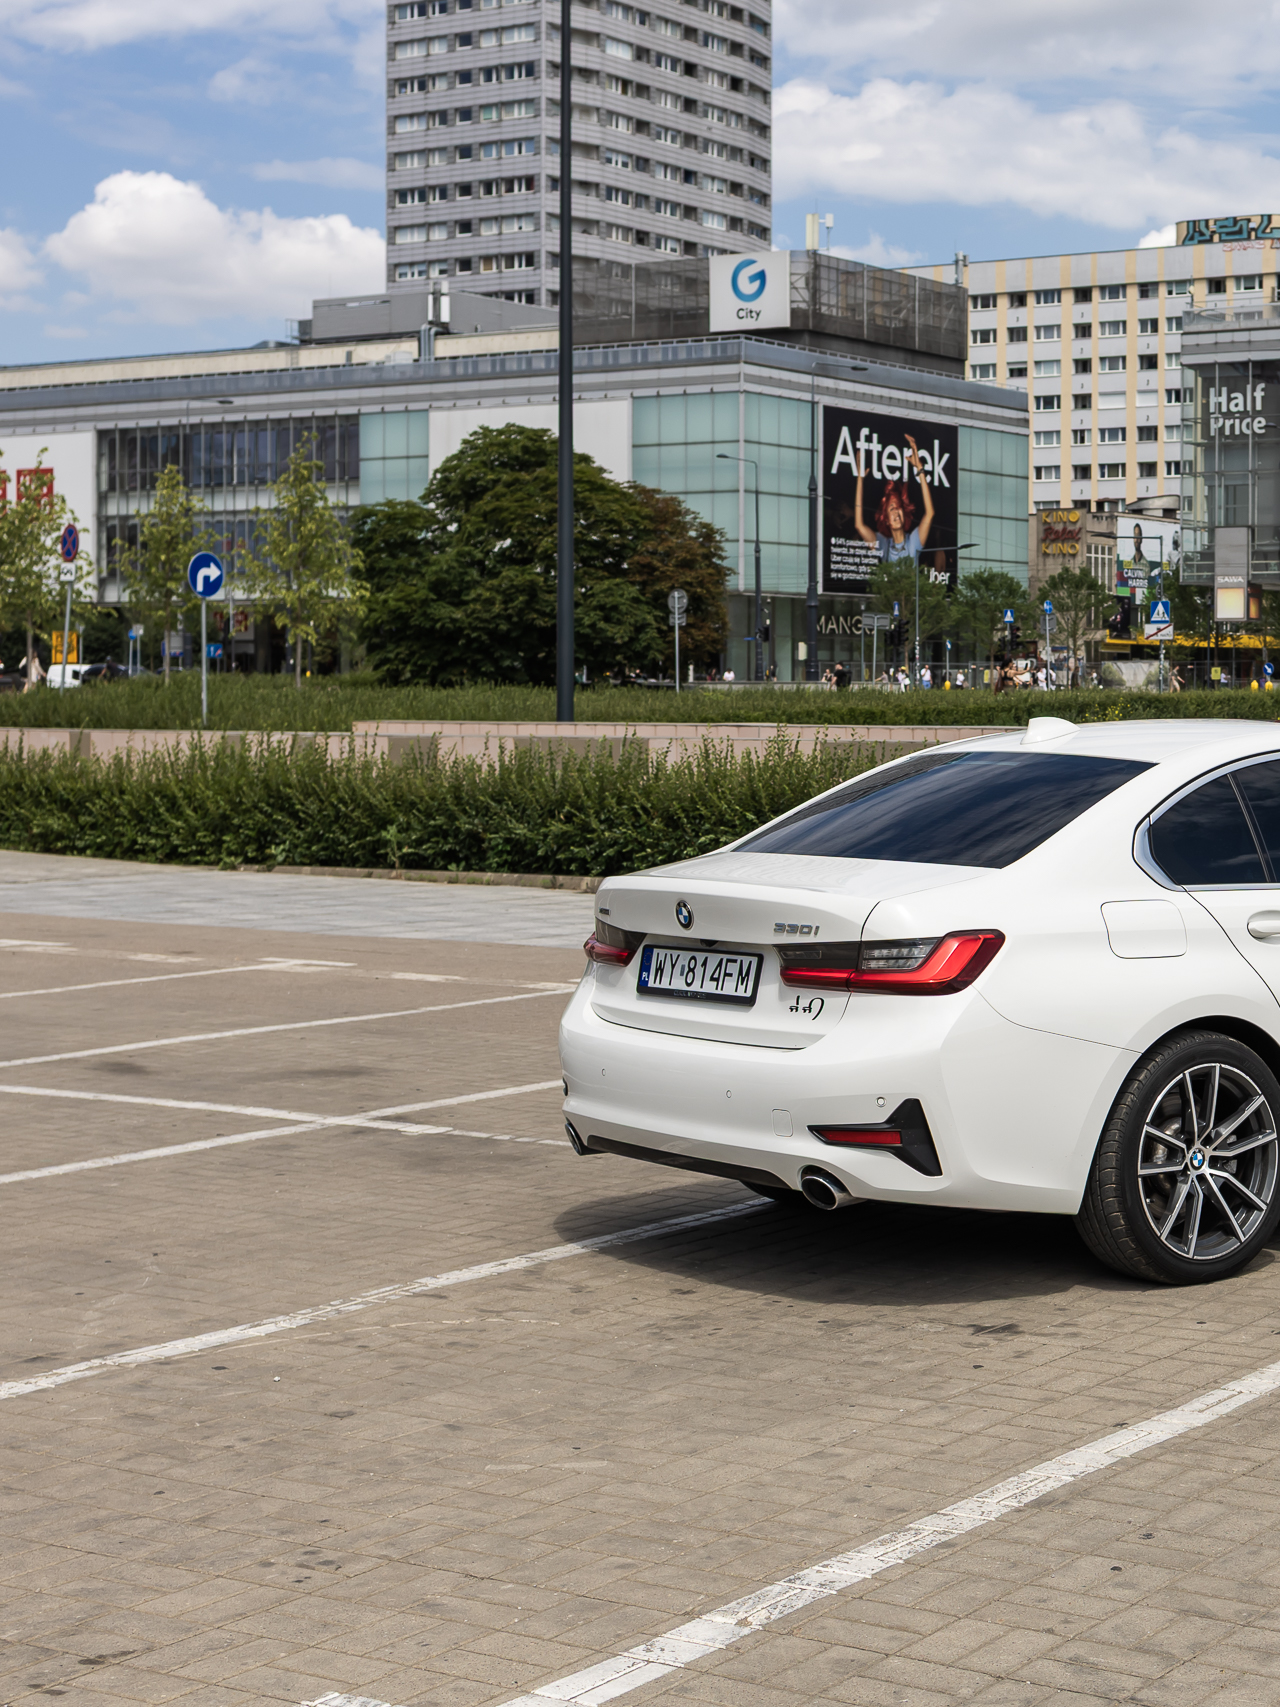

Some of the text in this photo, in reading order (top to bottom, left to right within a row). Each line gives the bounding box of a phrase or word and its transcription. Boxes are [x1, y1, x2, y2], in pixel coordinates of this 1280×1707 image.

[731, 258, 767, 303] G
[736, 307, 762, 321] City
[1209, 382, 1266, 413] Half
[1210, 413, 1267, 436] Price
[830, 425, 951, 488] Afterek
[1042, 510, 1080, 523] KINO
[1042, 526, 1082, 540] Relax
[1042, 542, 1080, 555] KINO
[1217, 575, 1245, 583] SAWA
[816, 615, 875, 635] MANG
[641, 971, 649, 981] PL
[653, 952, 753, 994] WY 814FM
